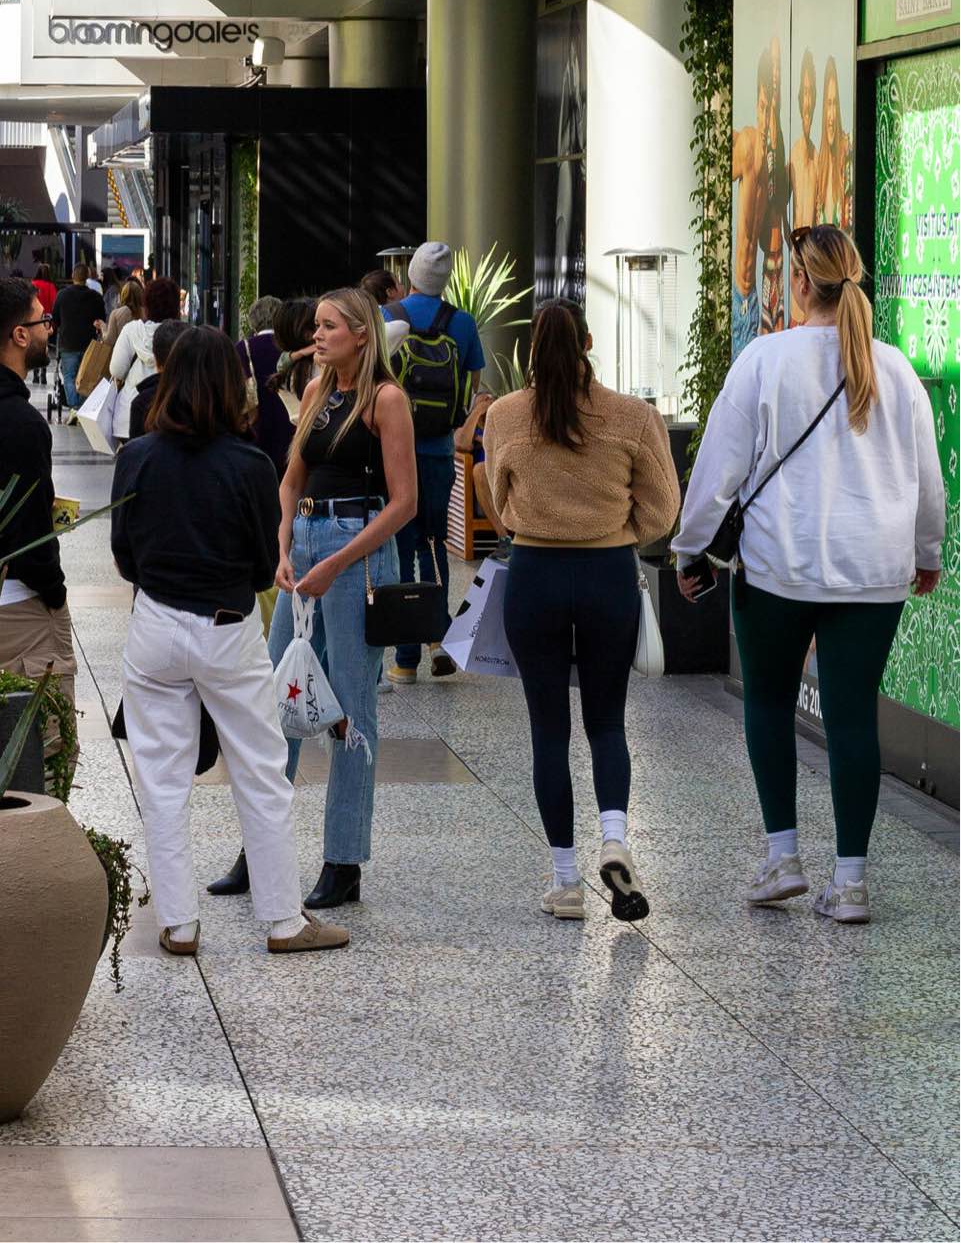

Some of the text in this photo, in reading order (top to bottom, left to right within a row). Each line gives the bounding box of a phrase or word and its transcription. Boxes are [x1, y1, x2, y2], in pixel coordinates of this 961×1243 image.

[916, 212, 936, 237] VISIT
[937, 212, 947, 237] US
[474, 655, 510, 666] NORDSTROM
